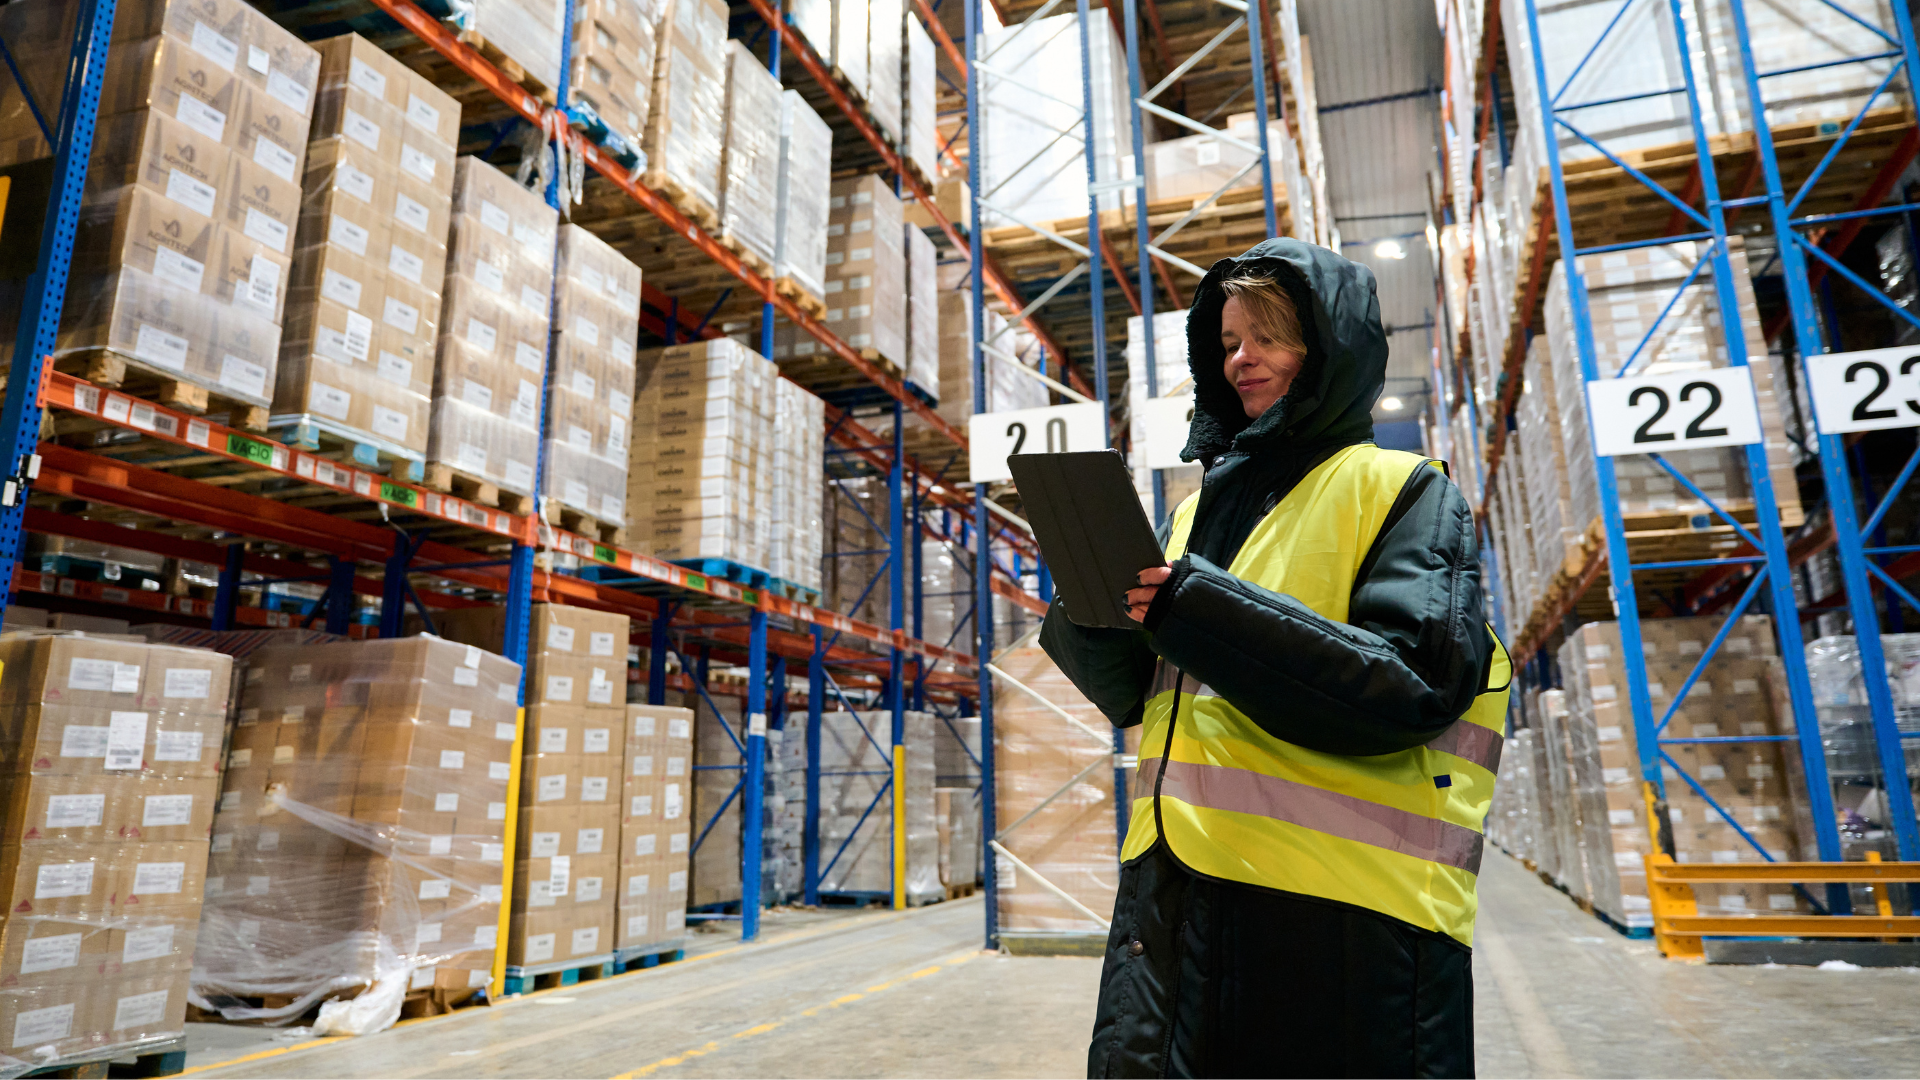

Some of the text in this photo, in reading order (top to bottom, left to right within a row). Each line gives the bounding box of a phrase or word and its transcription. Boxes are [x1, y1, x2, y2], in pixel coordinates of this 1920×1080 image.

[162, 153, 208, 180] AGRITECH
[240, 193, 282, 218] AGRITECH
[1628, 381, 1728, 443] 22
[1006, 417, 1068, 455] 20
